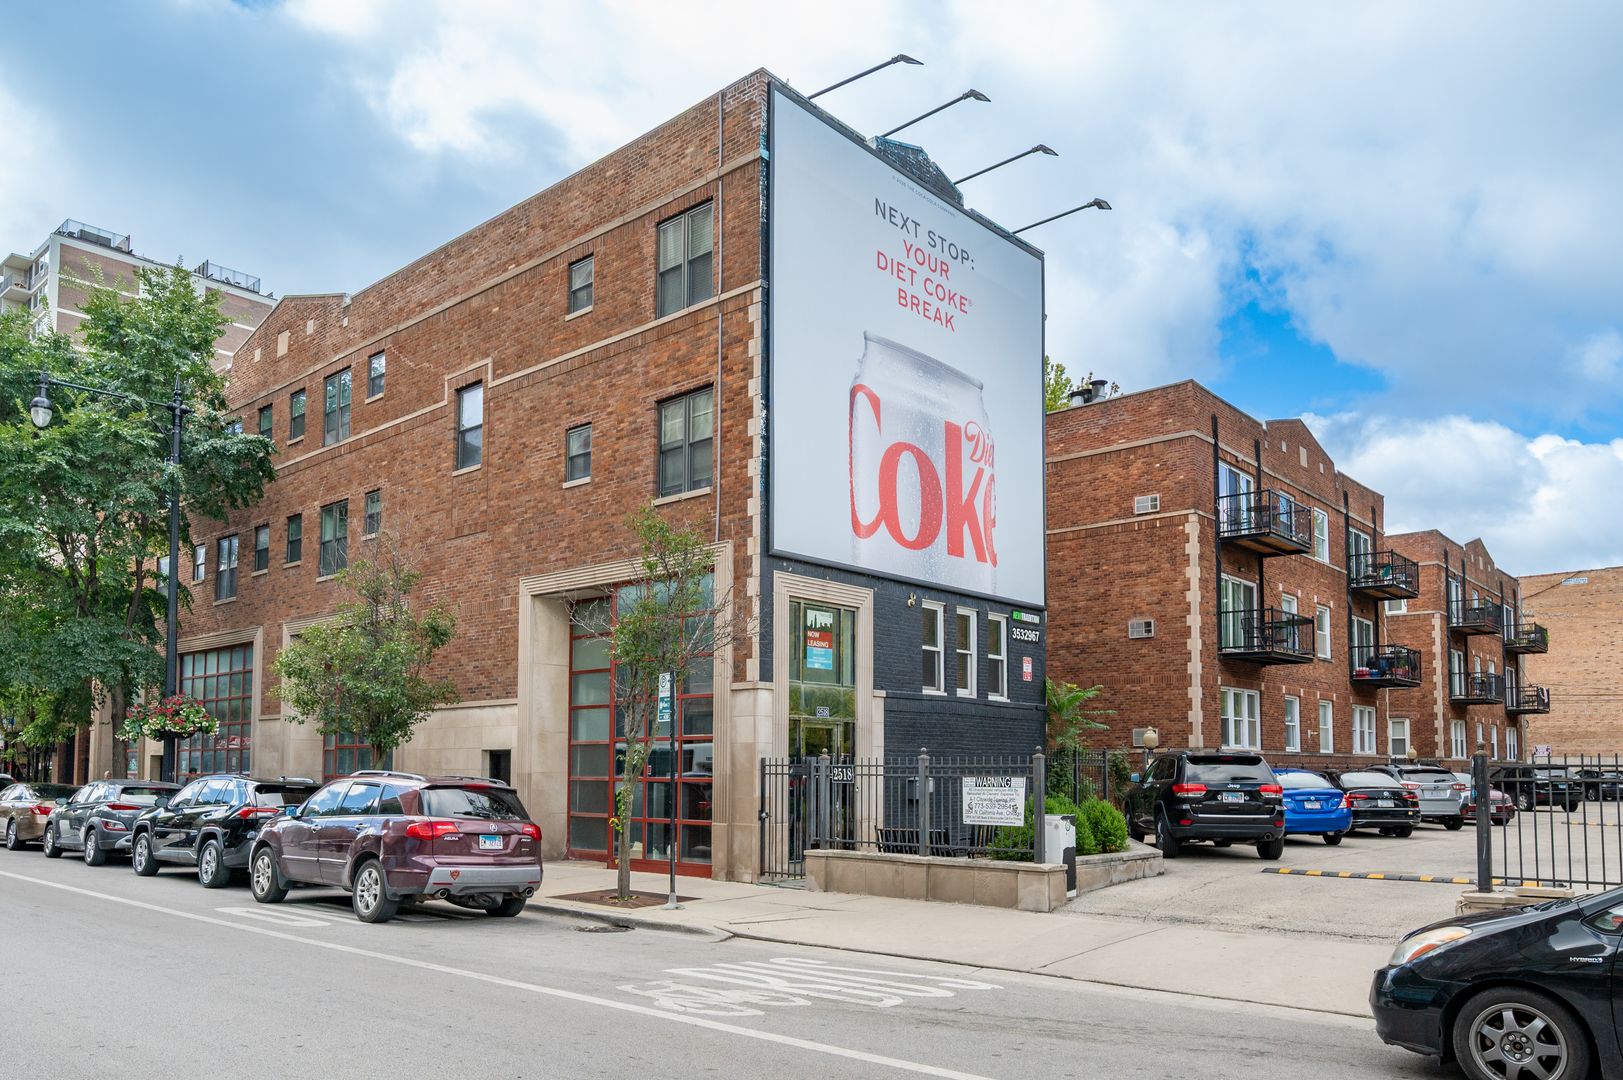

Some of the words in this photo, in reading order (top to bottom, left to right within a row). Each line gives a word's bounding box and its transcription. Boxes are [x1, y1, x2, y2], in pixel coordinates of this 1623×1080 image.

[875, 197, 921, 239] NEXT
[927, 230, 975, 270] STOP:
[876, 250, 918, 287] DIET
[903, 240, 950, 280] YOUR
[897, 287, 956, 333] BREAK
[849, 383, 998, 568] Coke
[807, 630, 820, 638] NOW
[808, 640, 829, 648] LEASING
[833, 768, 852, 780] 2518
[975, 776, 1011, 788] WARNING
